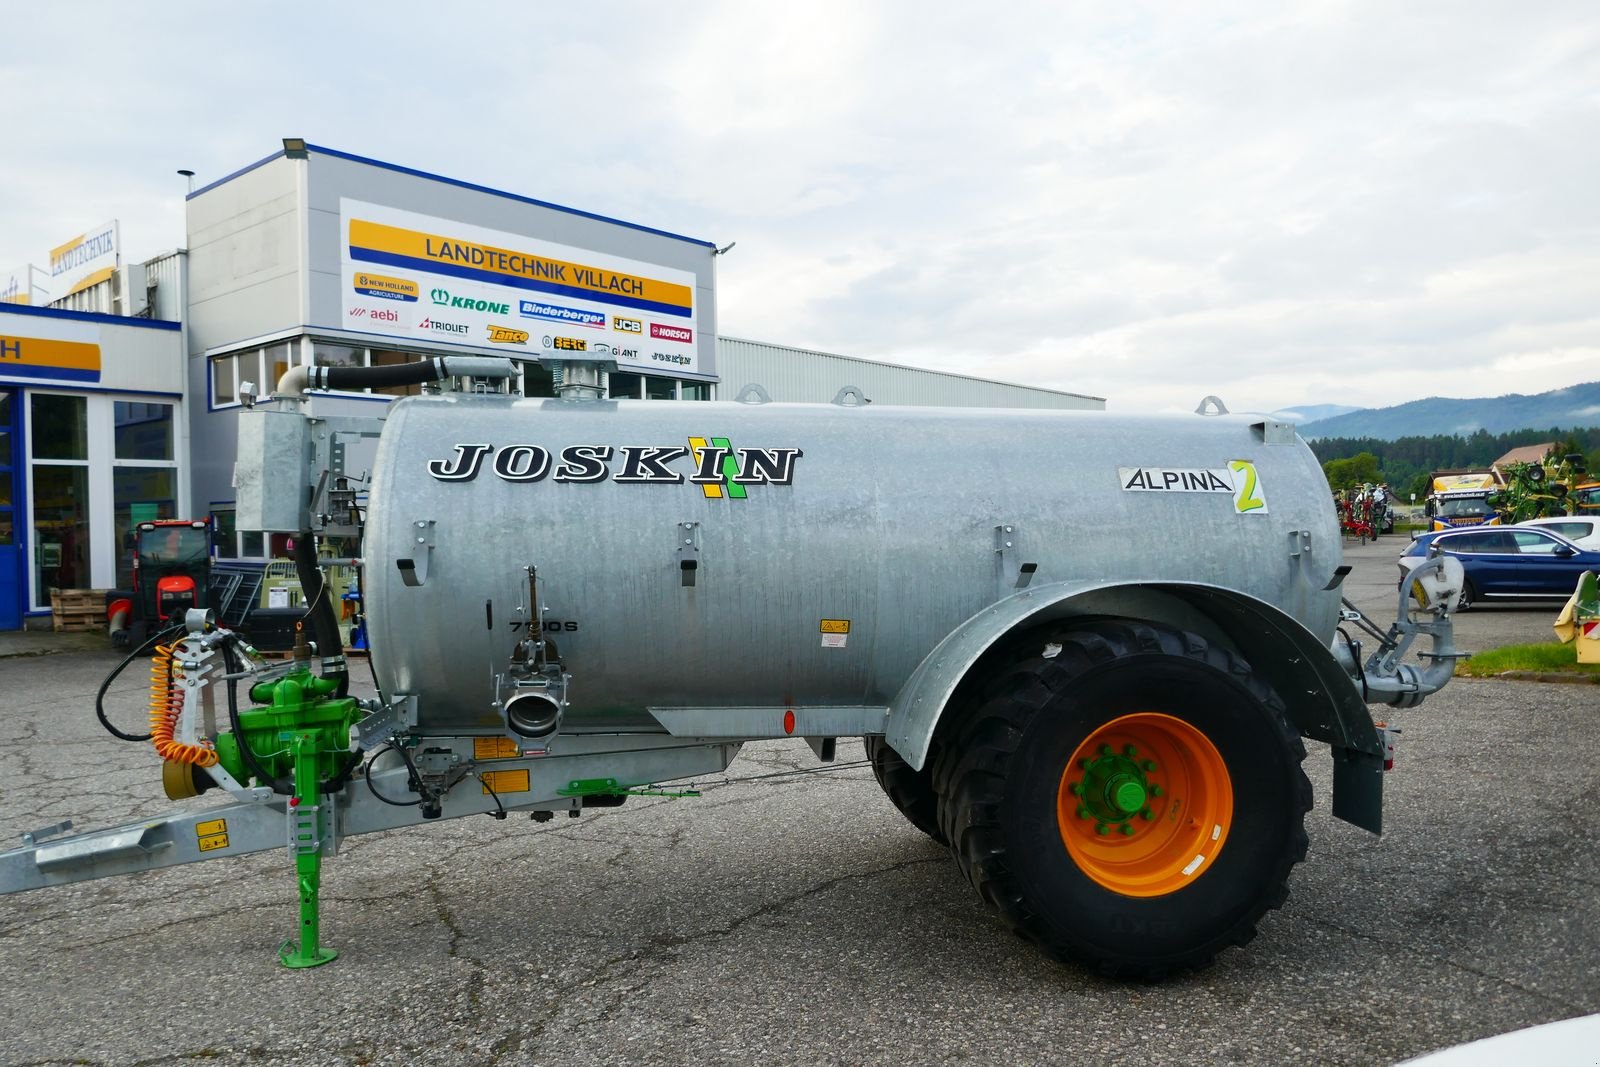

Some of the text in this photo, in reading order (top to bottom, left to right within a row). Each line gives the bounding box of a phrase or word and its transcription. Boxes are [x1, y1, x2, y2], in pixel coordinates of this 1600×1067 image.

[51, 229, 114, 277] LANDTECHNIK
[425, 238, 644, 296] LANDTECHNIK VILLACH
[369, 279, 414, 293] NEW HOLLAND
[368, 289, 405, 301] AGRICULTURE
[451, 296, 511, 315] KRONE
[521, 302, 604, 324] Binderberger
[370, 309, 399, 322] aebi
[429, 320, 470, 334] TRIOLIET
[614, 318, 642, 332] JCB
[486, 325, 530, 344] Tanco
[658, 327, 691, 340] HORSCH
[652, 352, 691, 366] JOSKIN
[427, 443, 804, 486] JOSKIN
[1125, 459, 1264, 513] ALPINA 2
